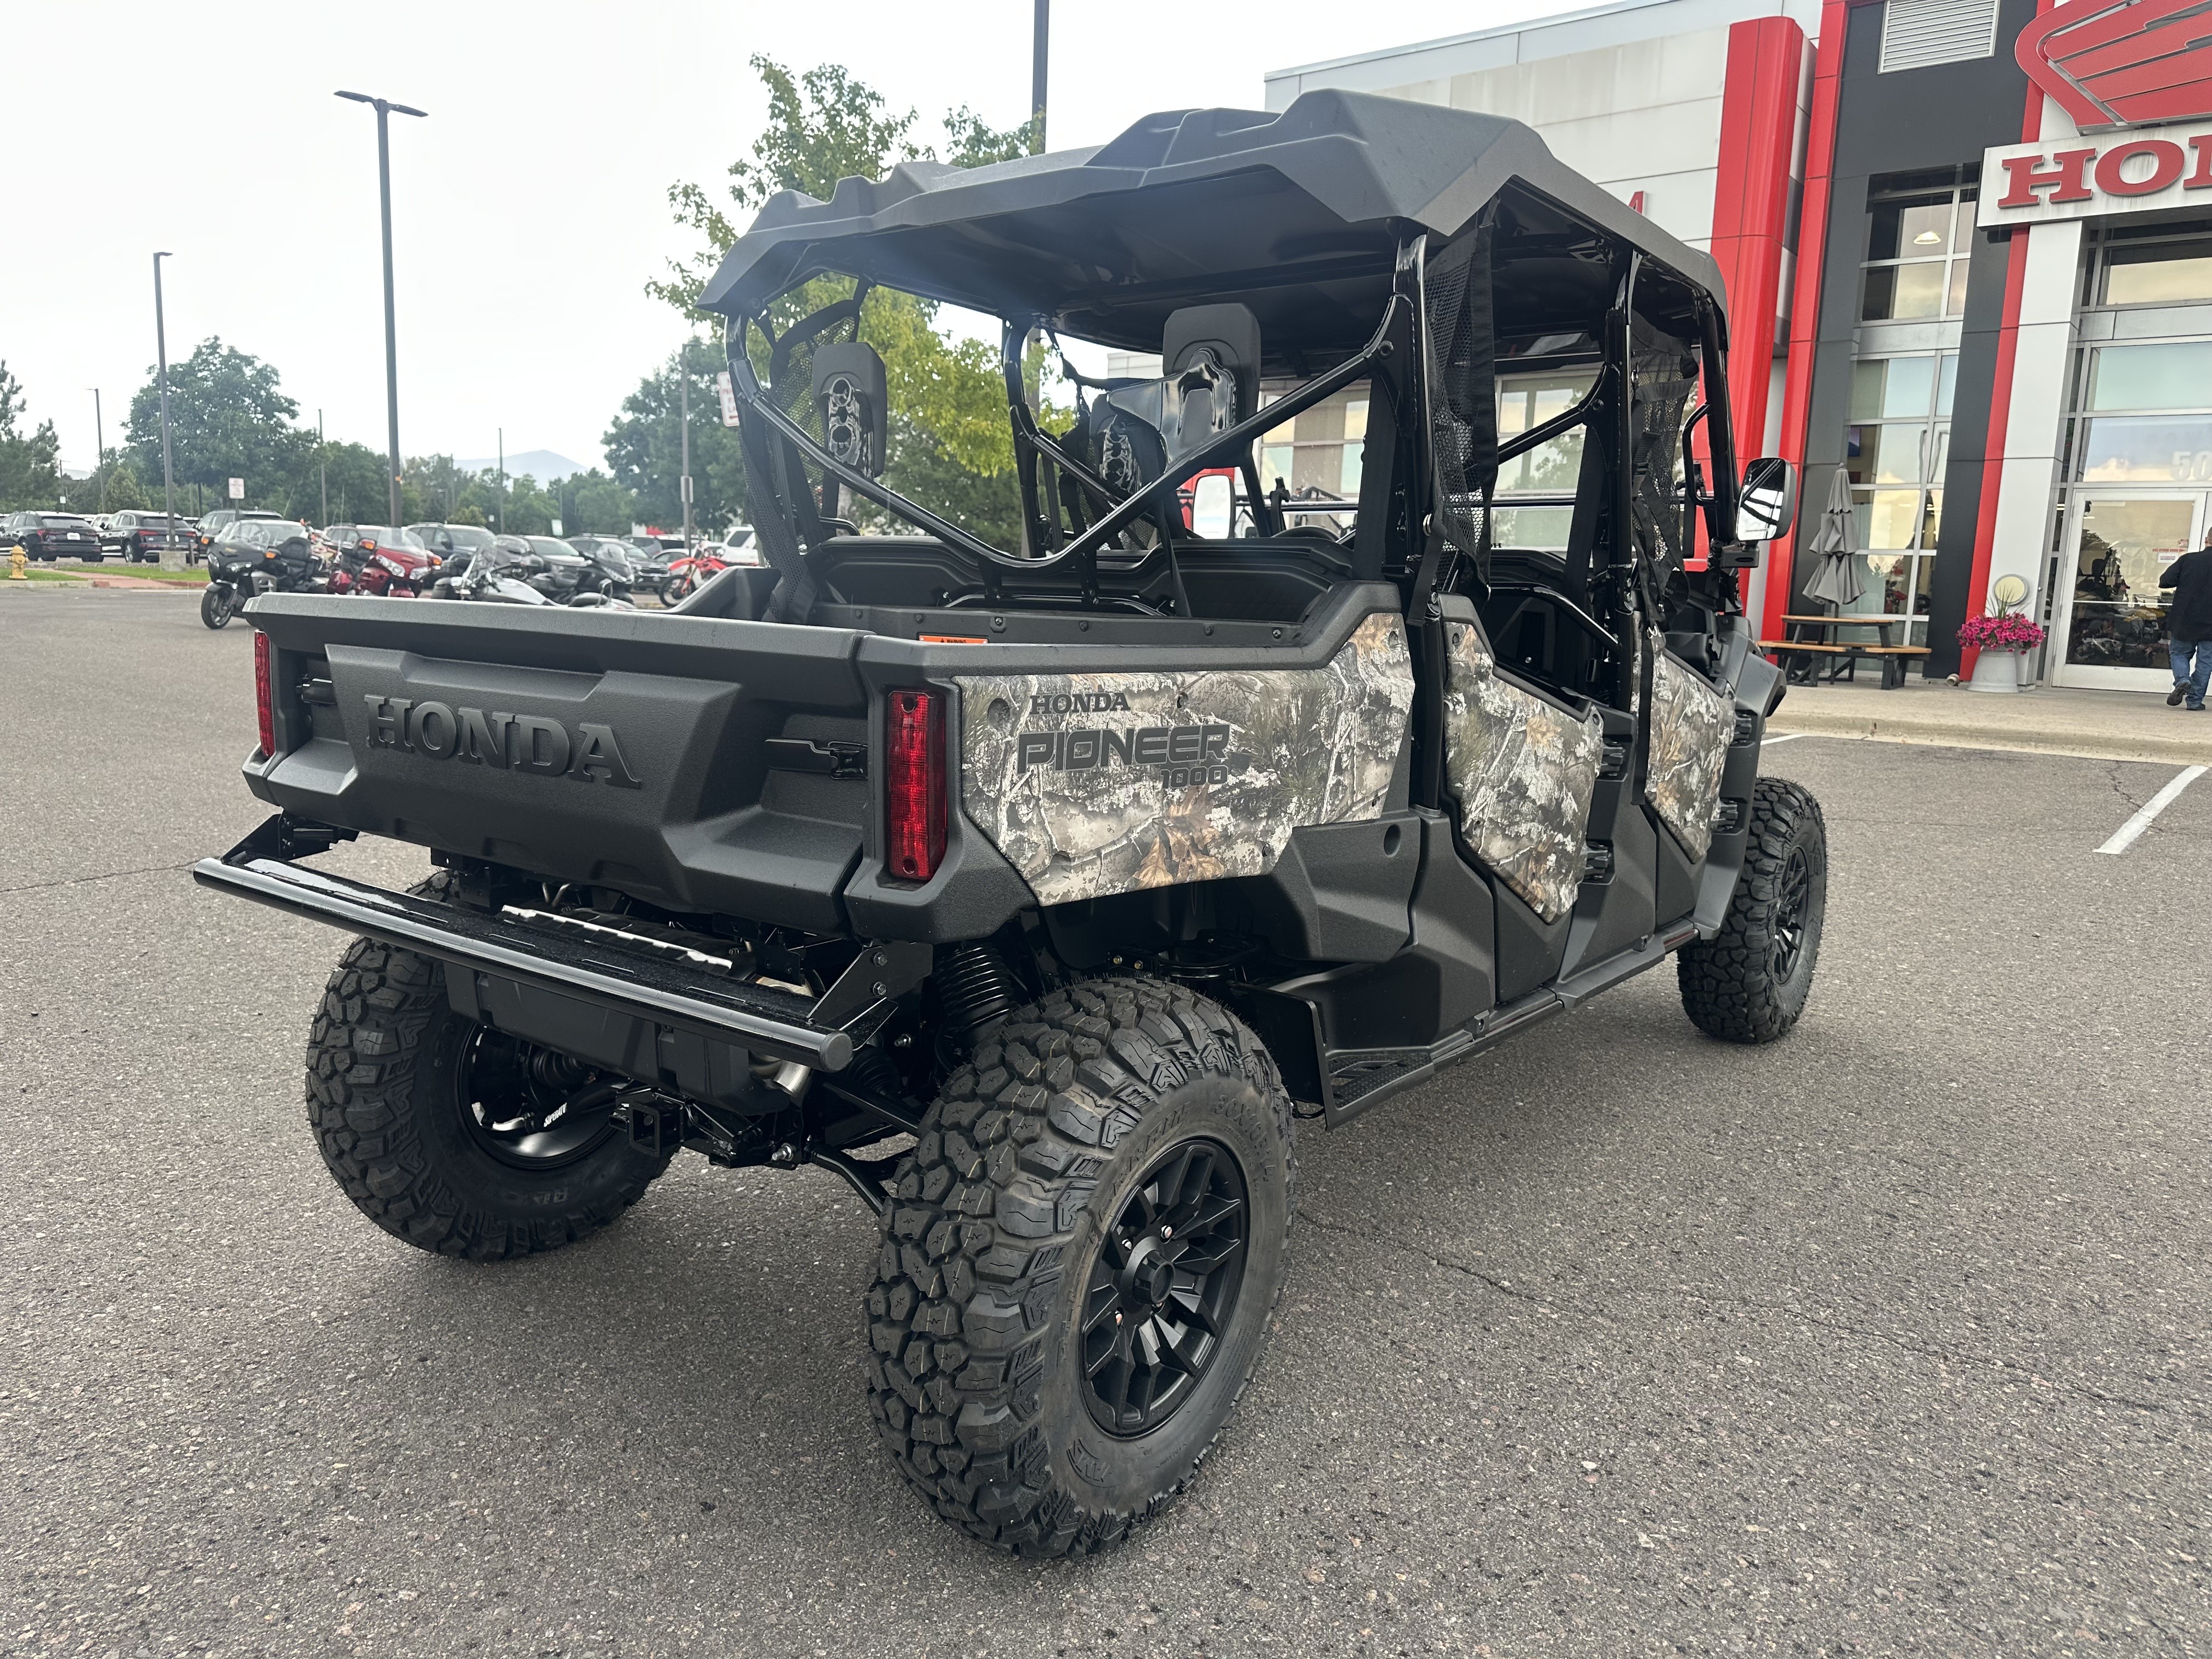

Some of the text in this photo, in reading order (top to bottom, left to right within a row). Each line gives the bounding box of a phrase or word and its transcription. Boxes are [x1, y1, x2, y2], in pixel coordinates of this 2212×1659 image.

[1030, 692, 1131, 714] HONDA
[364, 695, 641, 789] HONDA
[1017, 723, 1229, 775] PIONEER
[1161, 765, 1228, 789] 1000
